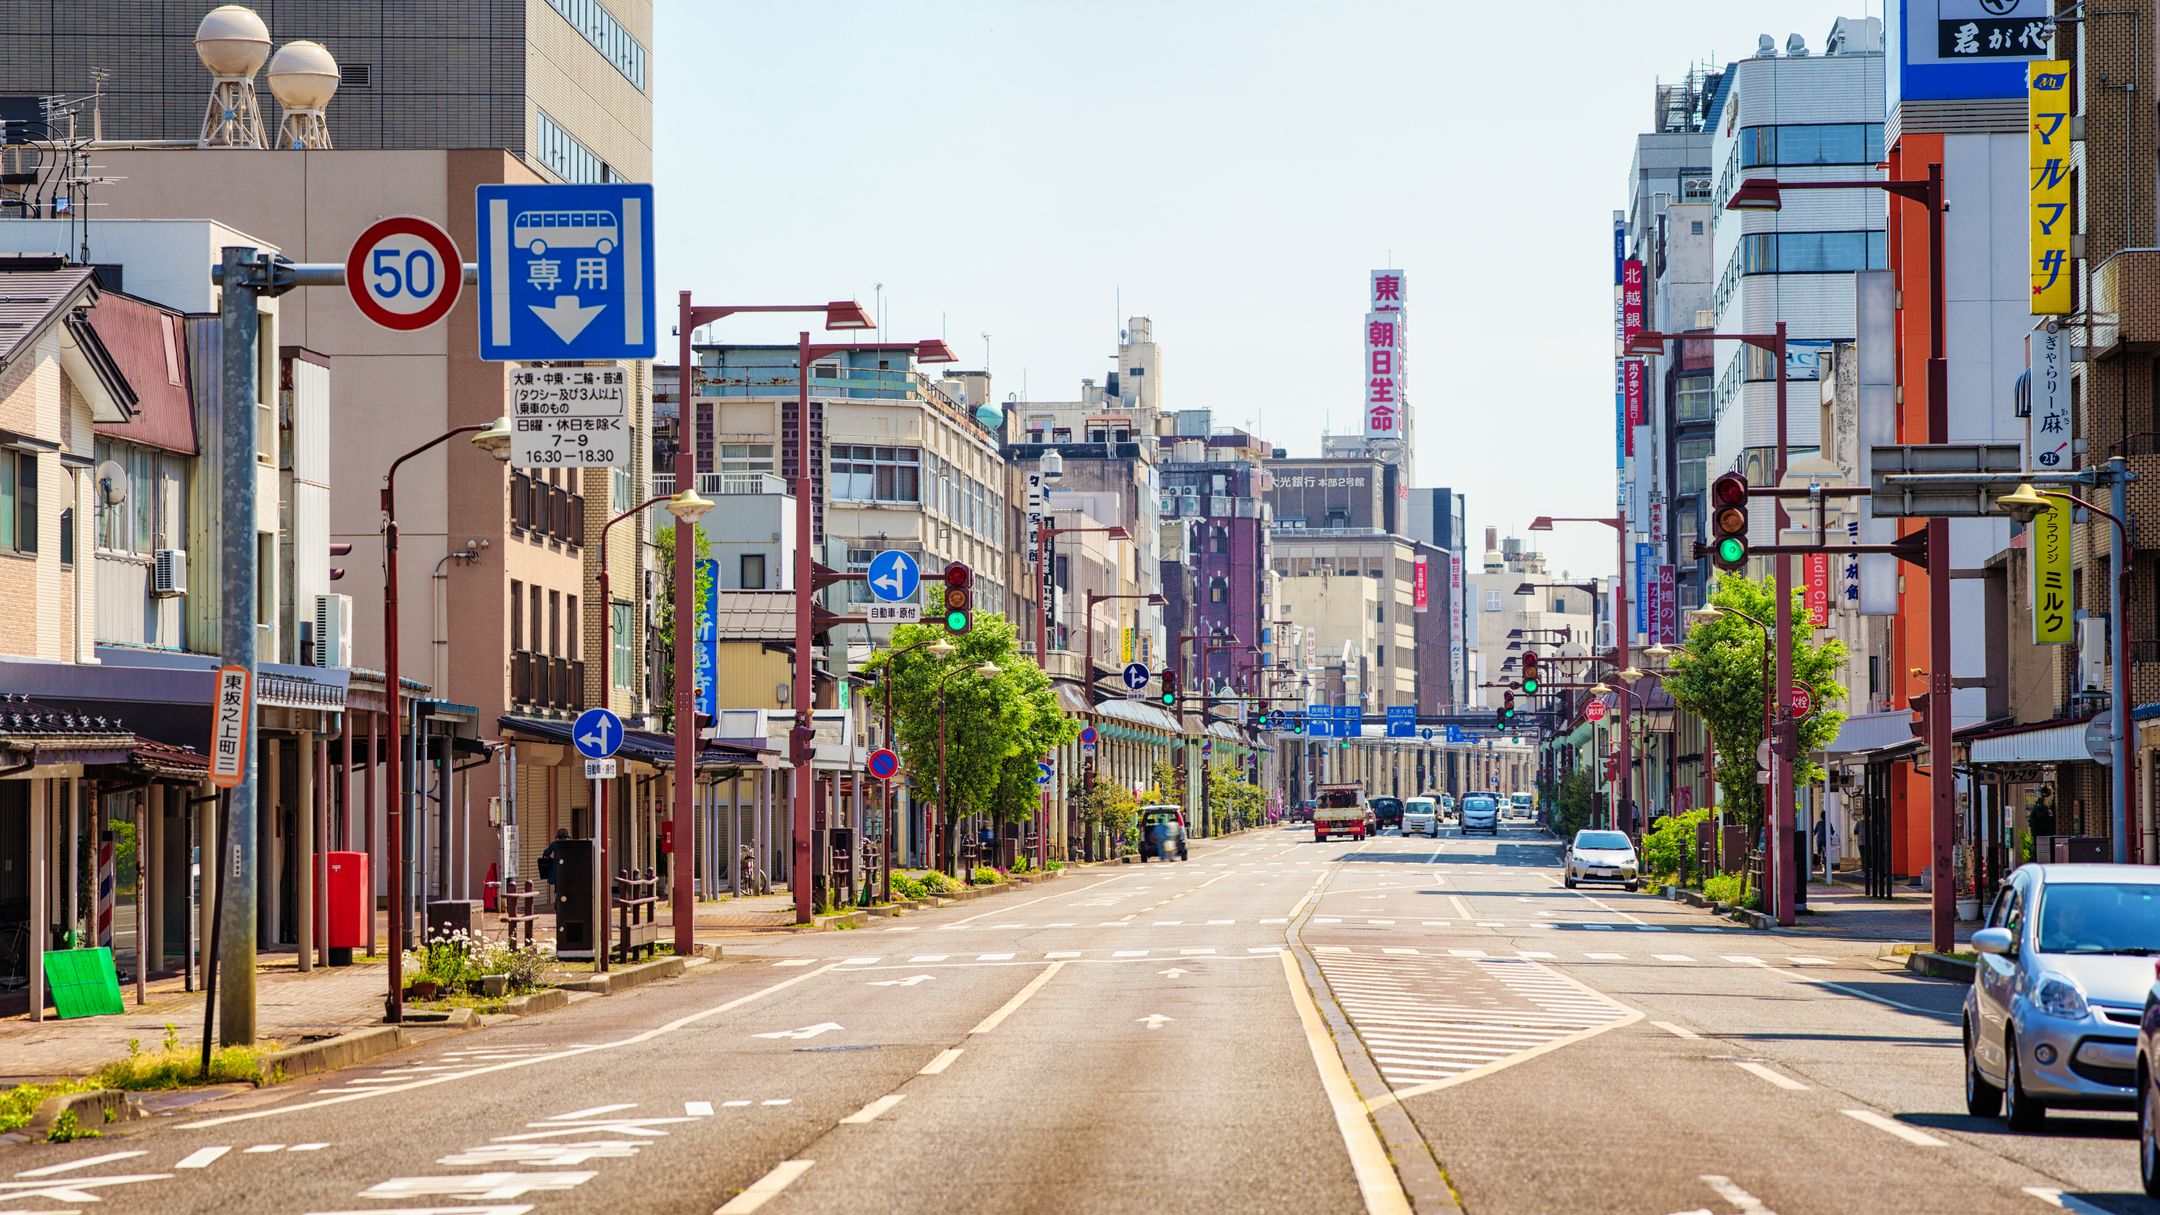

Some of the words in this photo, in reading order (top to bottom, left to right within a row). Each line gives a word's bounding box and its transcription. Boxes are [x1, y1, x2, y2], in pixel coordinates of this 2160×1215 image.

[1953, 22, 2047, 54] 君が代
[2031, 113, 2070, 291] マルマサ
[373, 249, 435, 298] 50
[527, 258, 608, 291] 専用
[1369, 320, 1394, 432] 朝日生命
[517, 418, 621, 432] 日曜・休日を除く
[2042, 453, 2057, 464] 2F
[1272, 476, 1315, 488] 大光銀行
[1814, 553, 1826, 587] udio
[1814, 590, 1826, 622] Ciao
[2043, 571, 2064, 633] ミルク
[217, 675, 242, 771] 東坂之上町三
[2004, 769, 2038, 781] ルマサ
